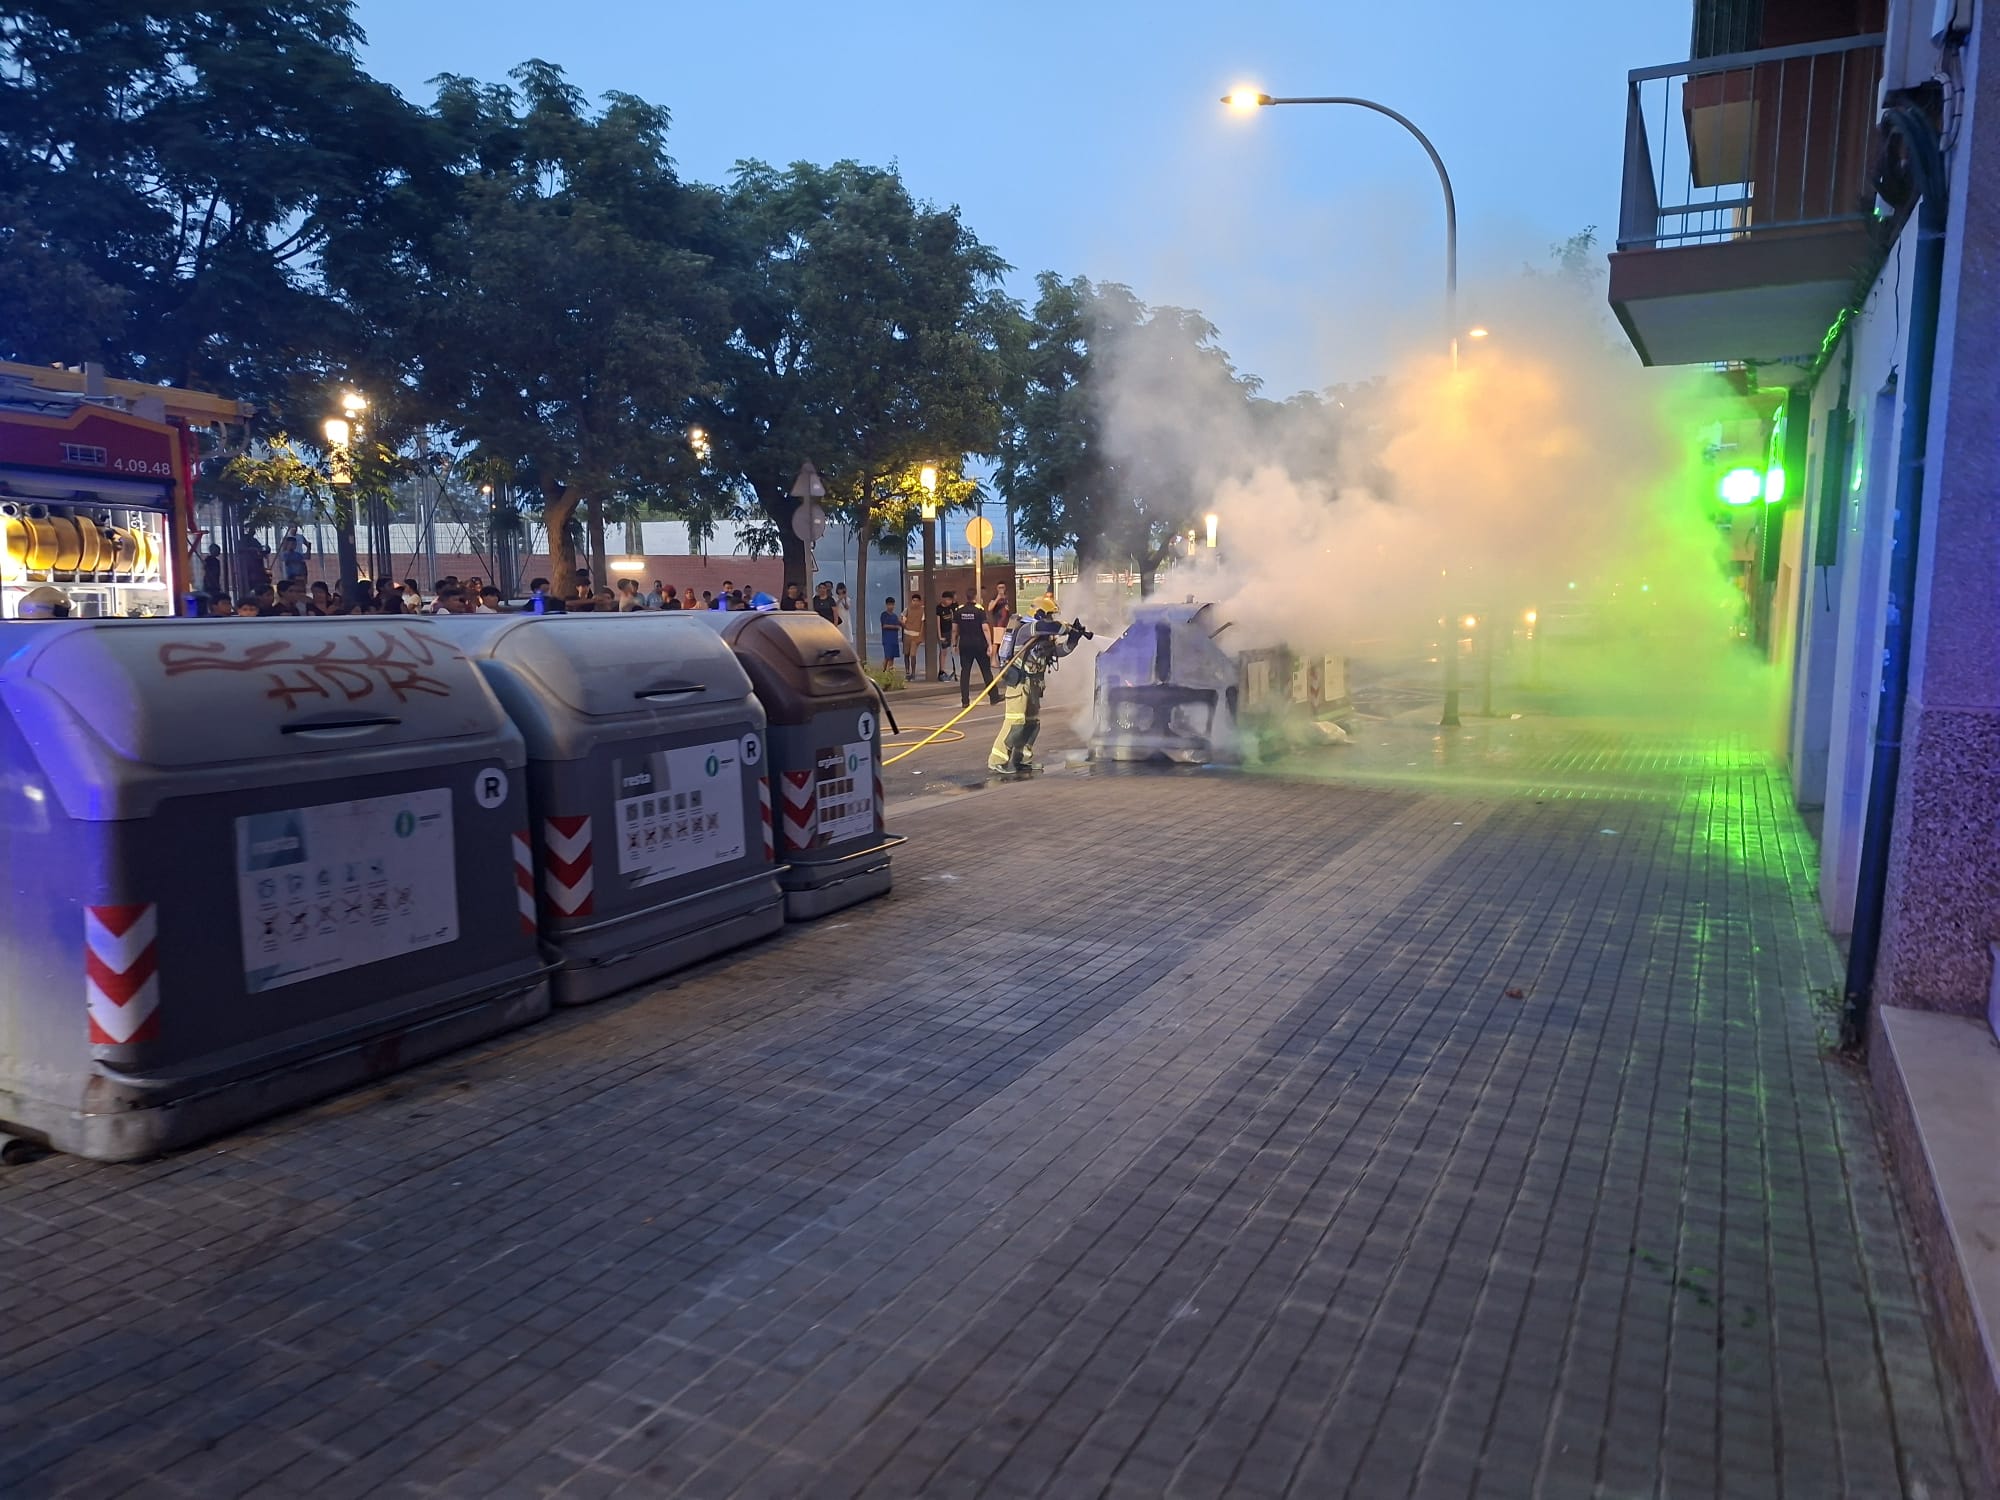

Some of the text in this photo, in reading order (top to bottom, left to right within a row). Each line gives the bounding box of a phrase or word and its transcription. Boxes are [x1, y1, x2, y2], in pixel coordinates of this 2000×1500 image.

[114, 458, 170, 475] 4.09.48
[746, 740, 757, 758] R
[484, 776, 500, 799] R
